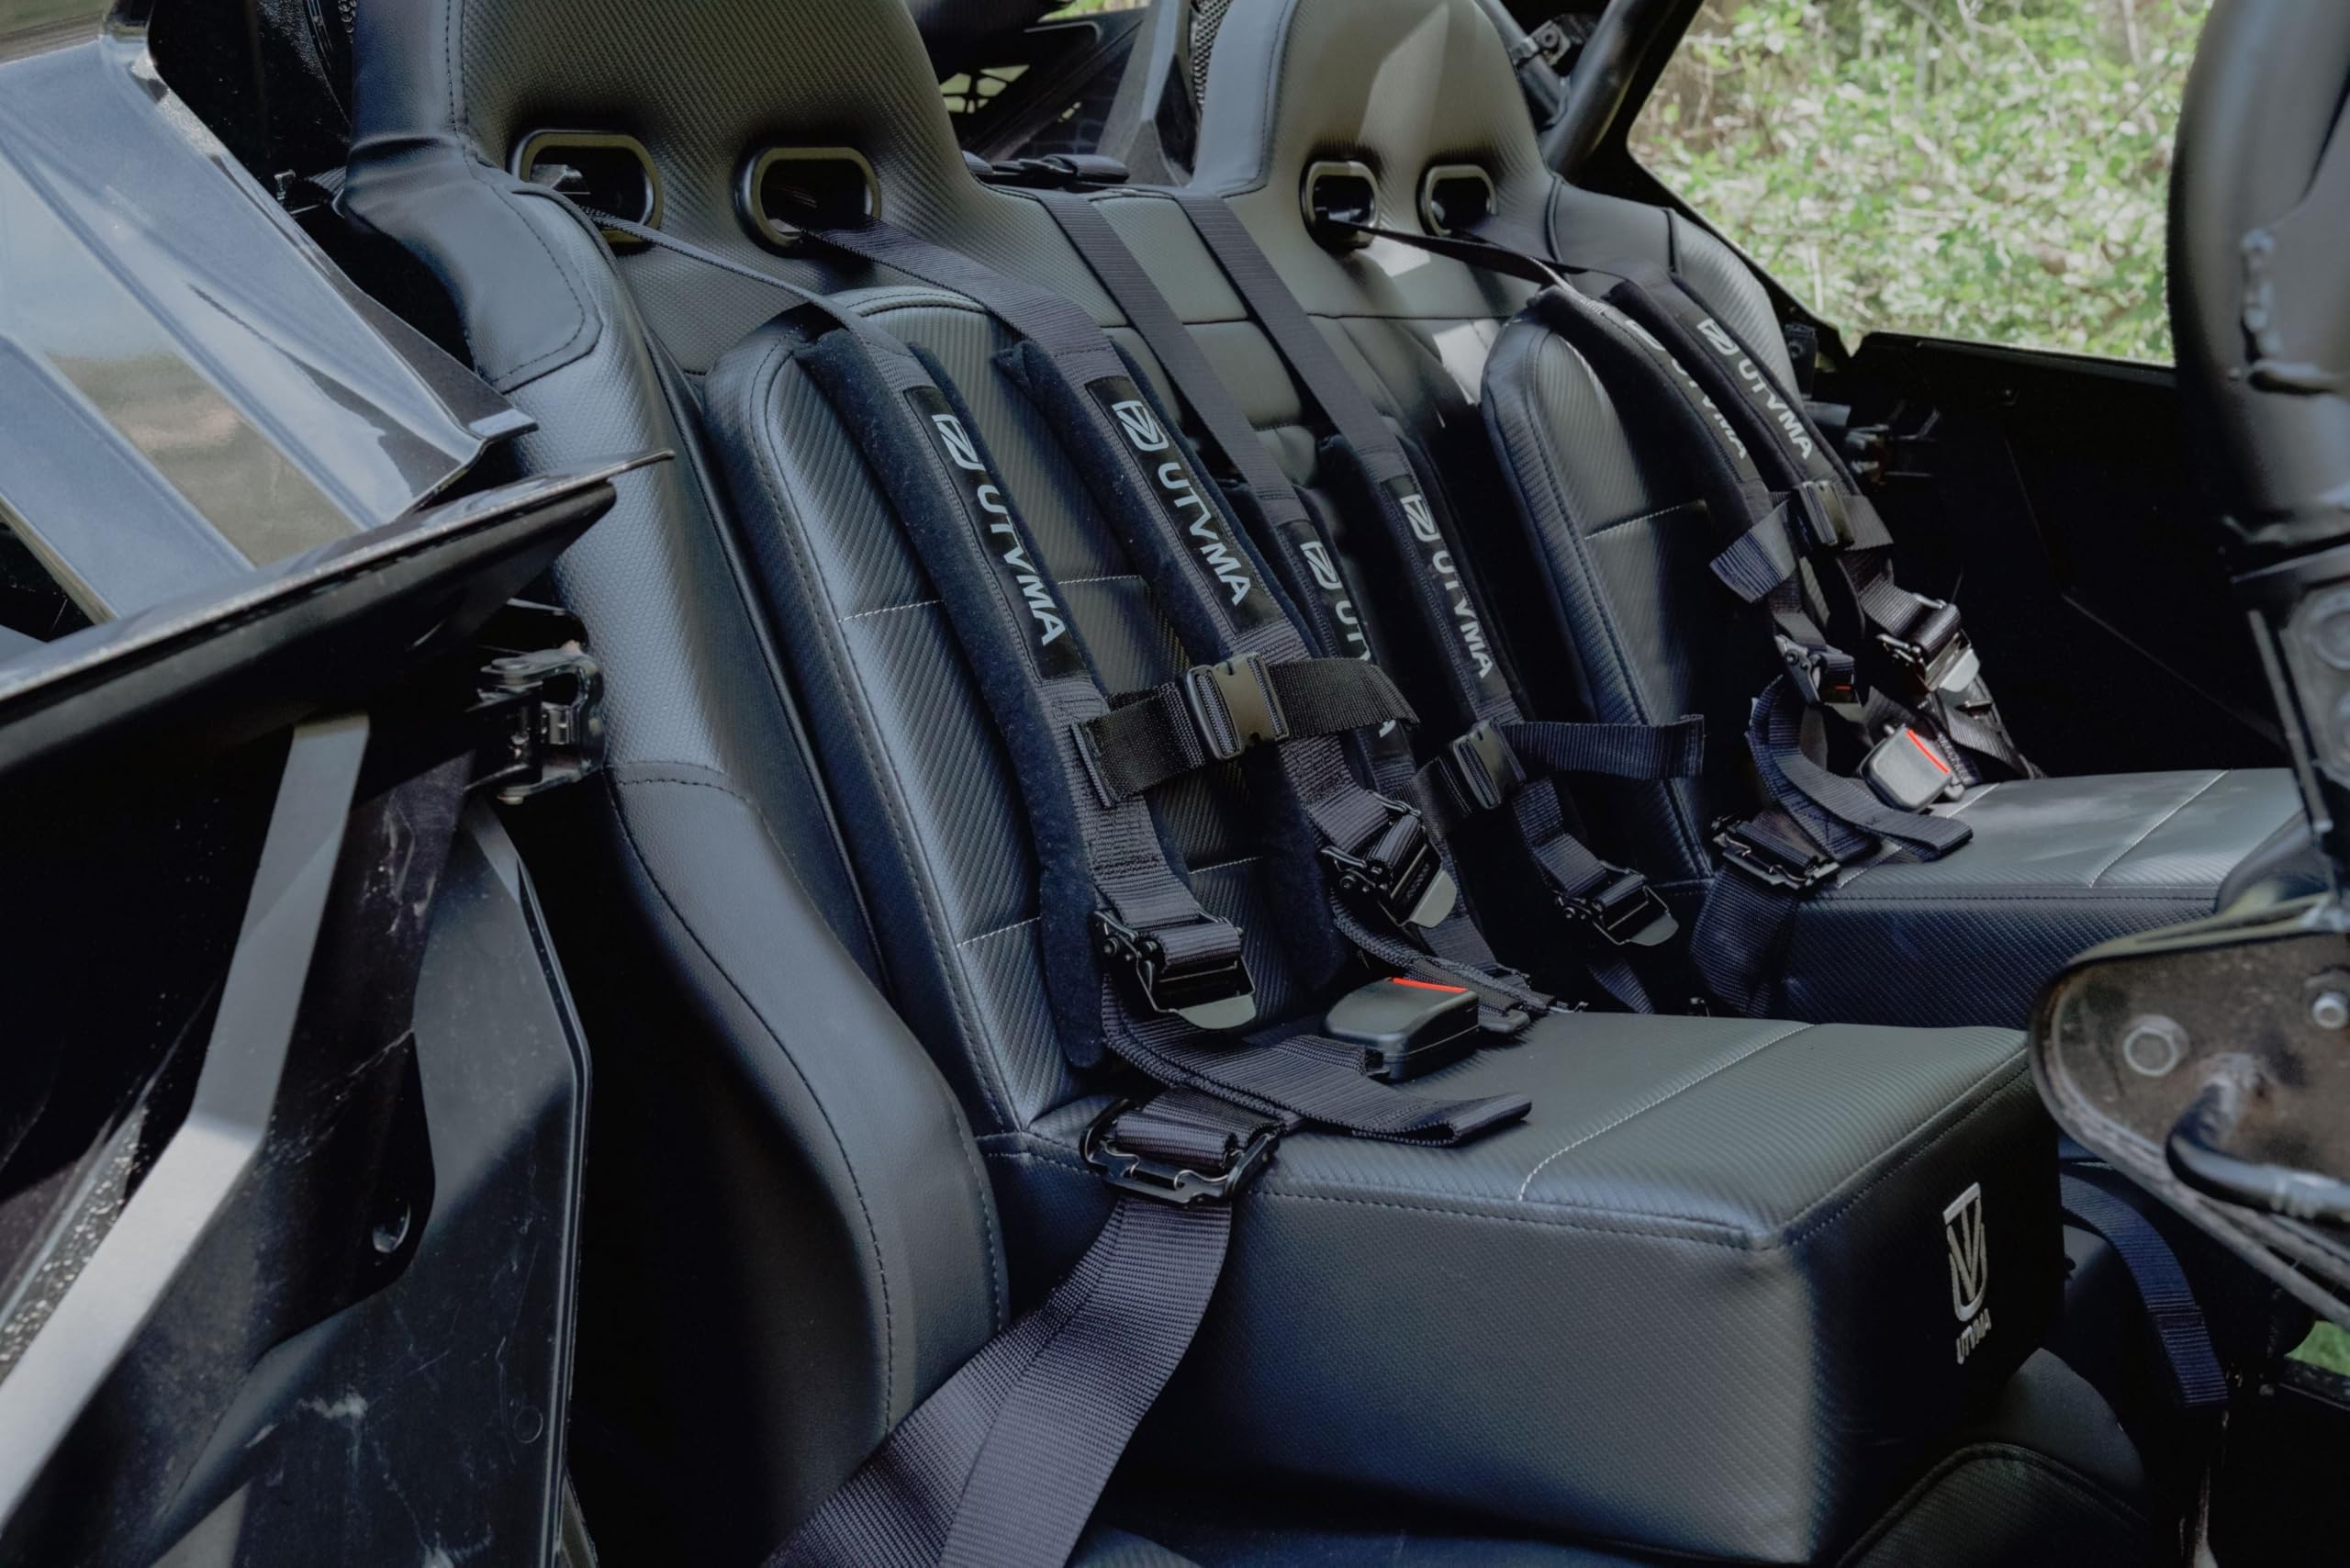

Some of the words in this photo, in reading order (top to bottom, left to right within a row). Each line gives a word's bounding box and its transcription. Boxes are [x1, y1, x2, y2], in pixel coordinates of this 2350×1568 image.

[1738, 359, 1813, 459] UTVMA
[977, 484, 1067, 645] UTVMA
[1158, 462, 1251, 606] UTVMA
[1955, 1307, 1992, 1365] UTVMA
